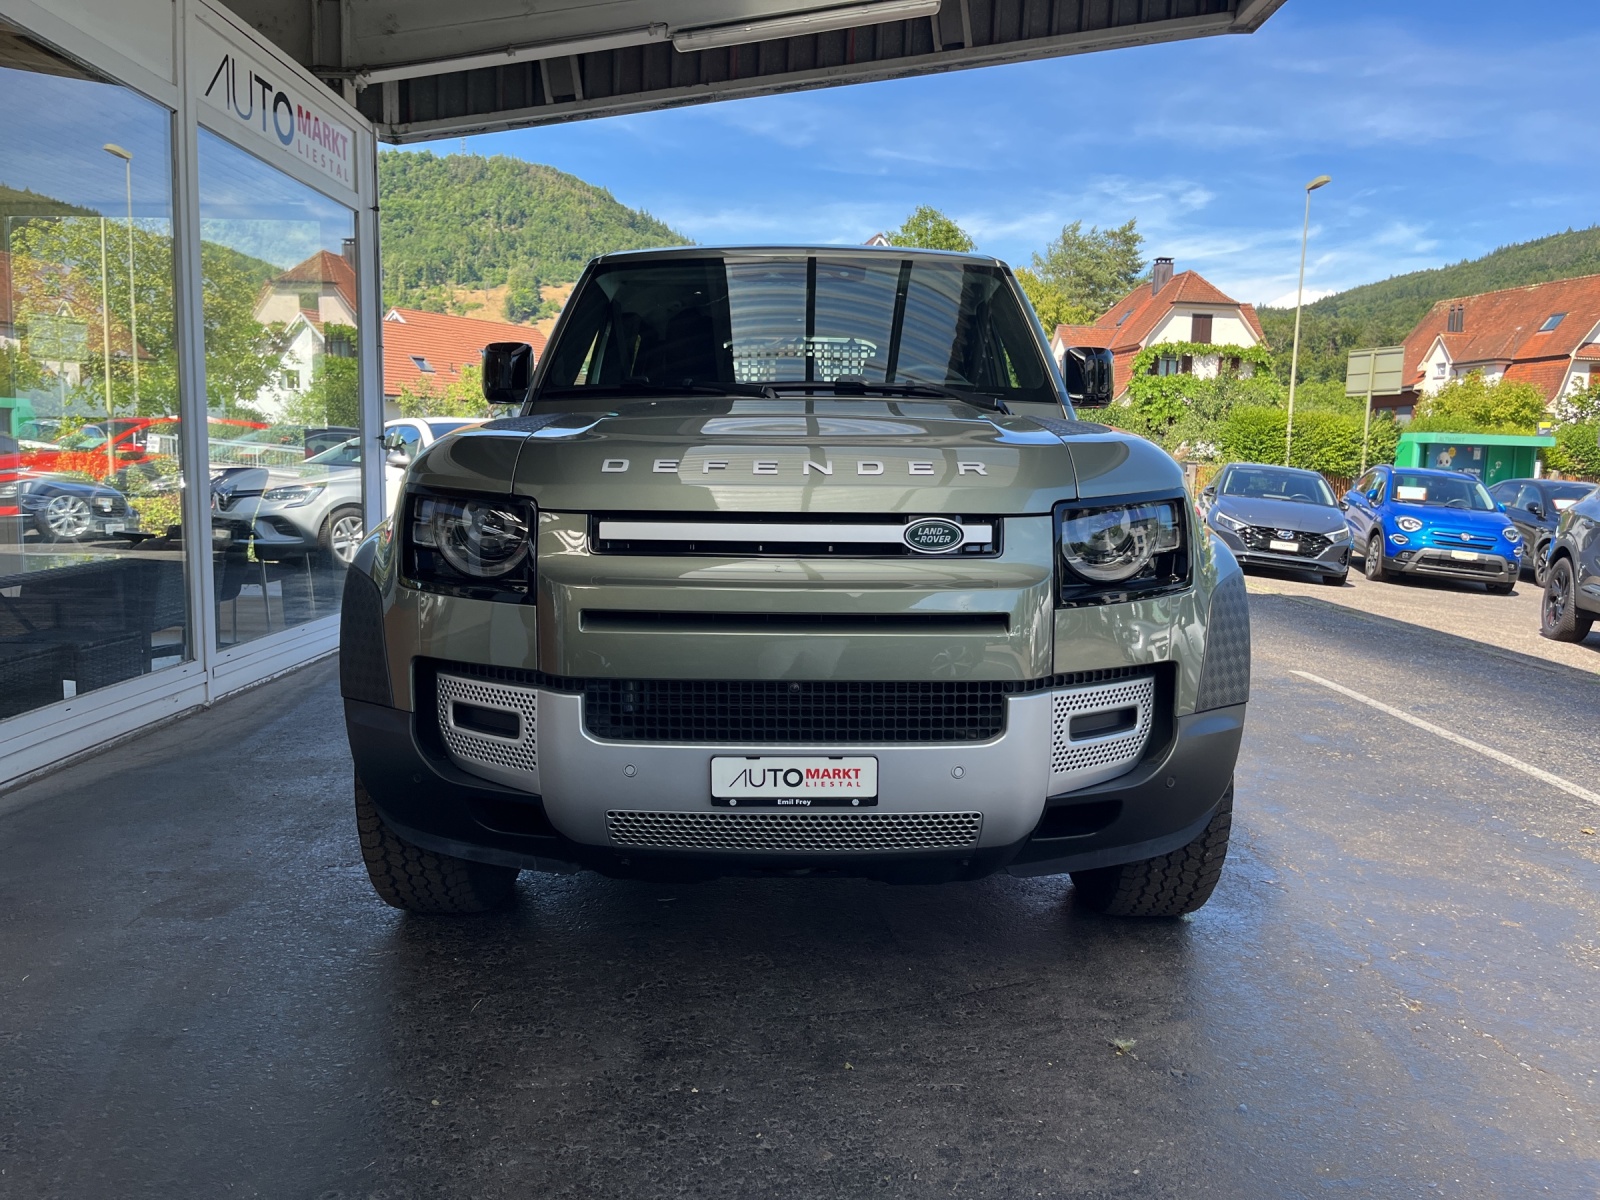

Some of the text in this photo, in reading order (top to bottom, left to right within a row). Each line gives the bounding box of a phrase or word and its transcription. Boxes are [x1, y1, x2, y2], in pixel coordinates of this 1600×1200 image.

[205, 54, 348, 161] AUTO MARKT
[297, 139, 349, 183] LIESTAL
[601, 459, 988, 476] DEFENDER
[918, 527, 943, 535] LAND
[920, 535, 951, 543] ROVER
[729, 768, 861, 788] AUTO MARKT
